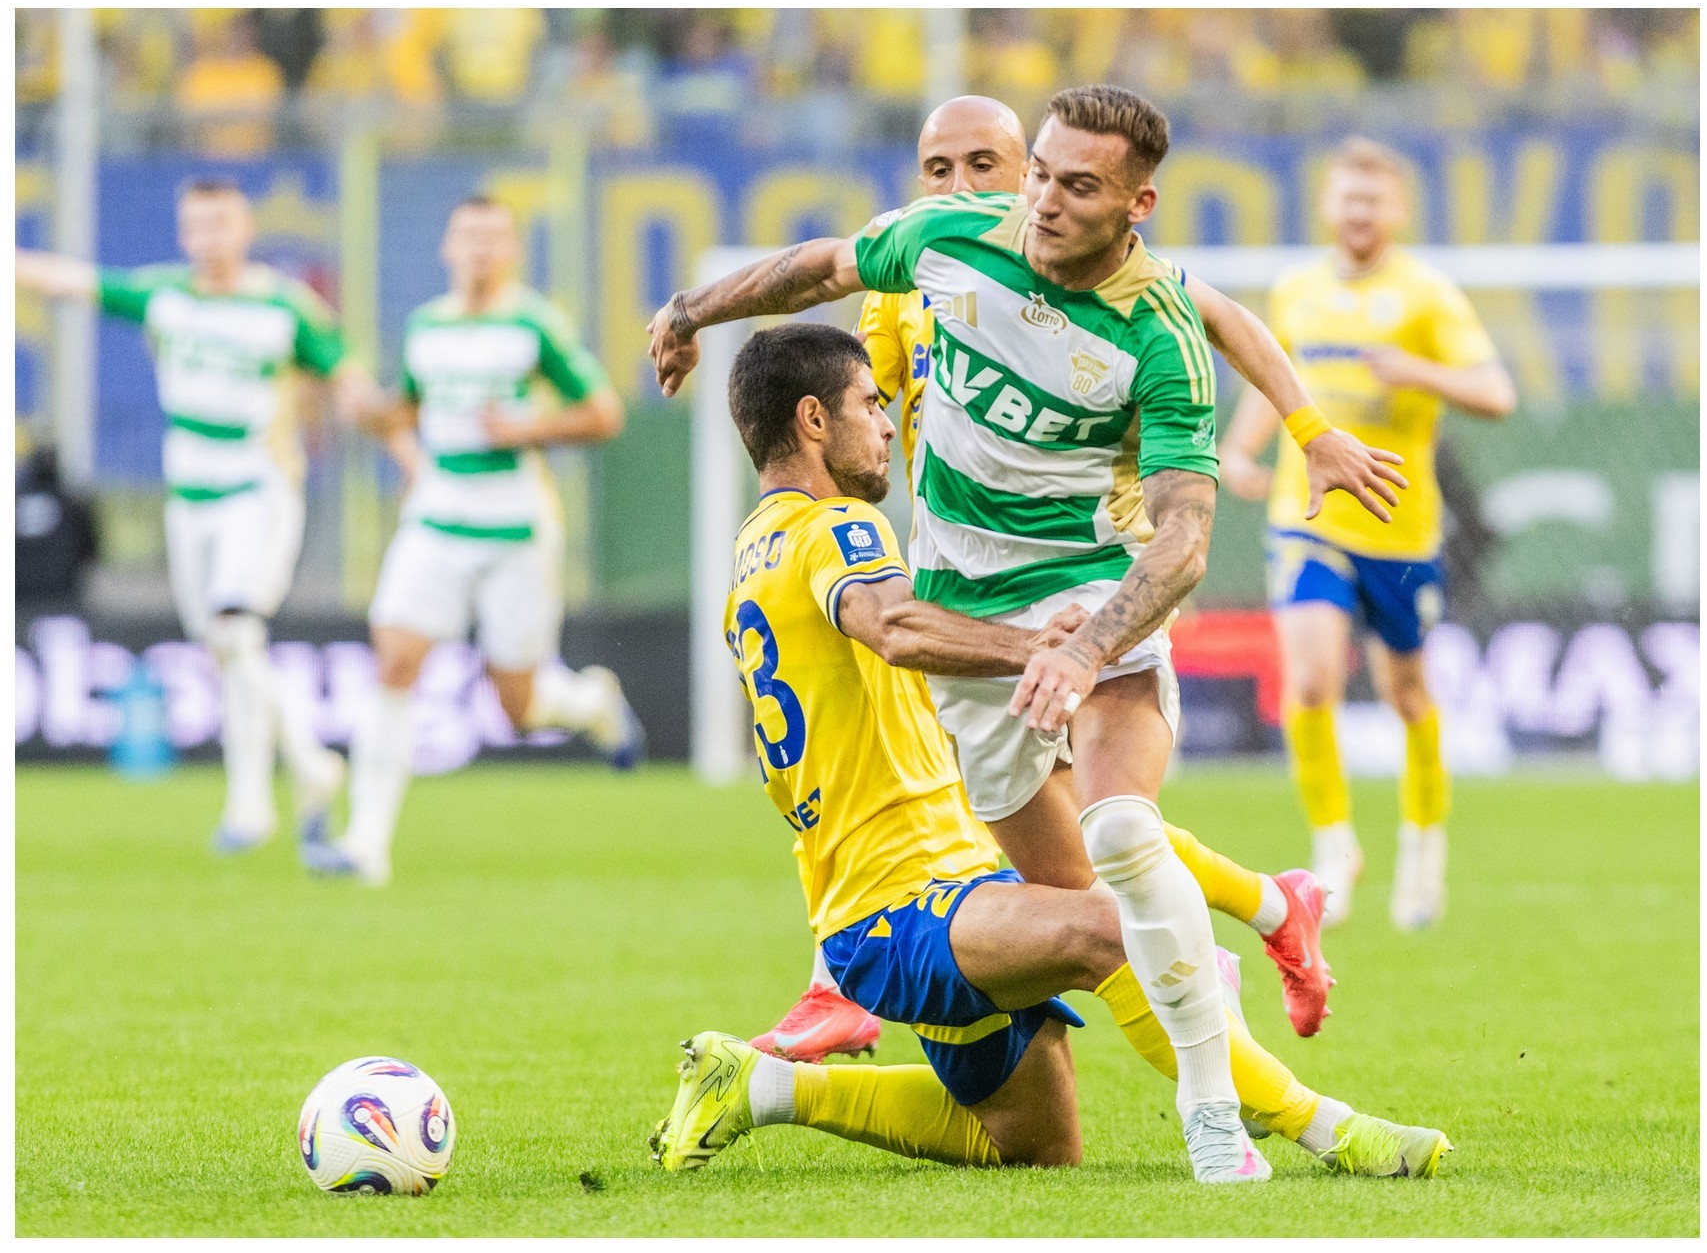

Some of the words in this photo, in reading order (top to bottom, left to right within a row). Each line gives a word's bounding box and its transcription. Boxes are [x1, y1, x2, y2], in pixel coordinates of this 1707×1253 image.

[1030, 306, 1060, 327] LOTTO
[1072, 373, 1092, 395] 80
[726, 599, 807, 770] 3
